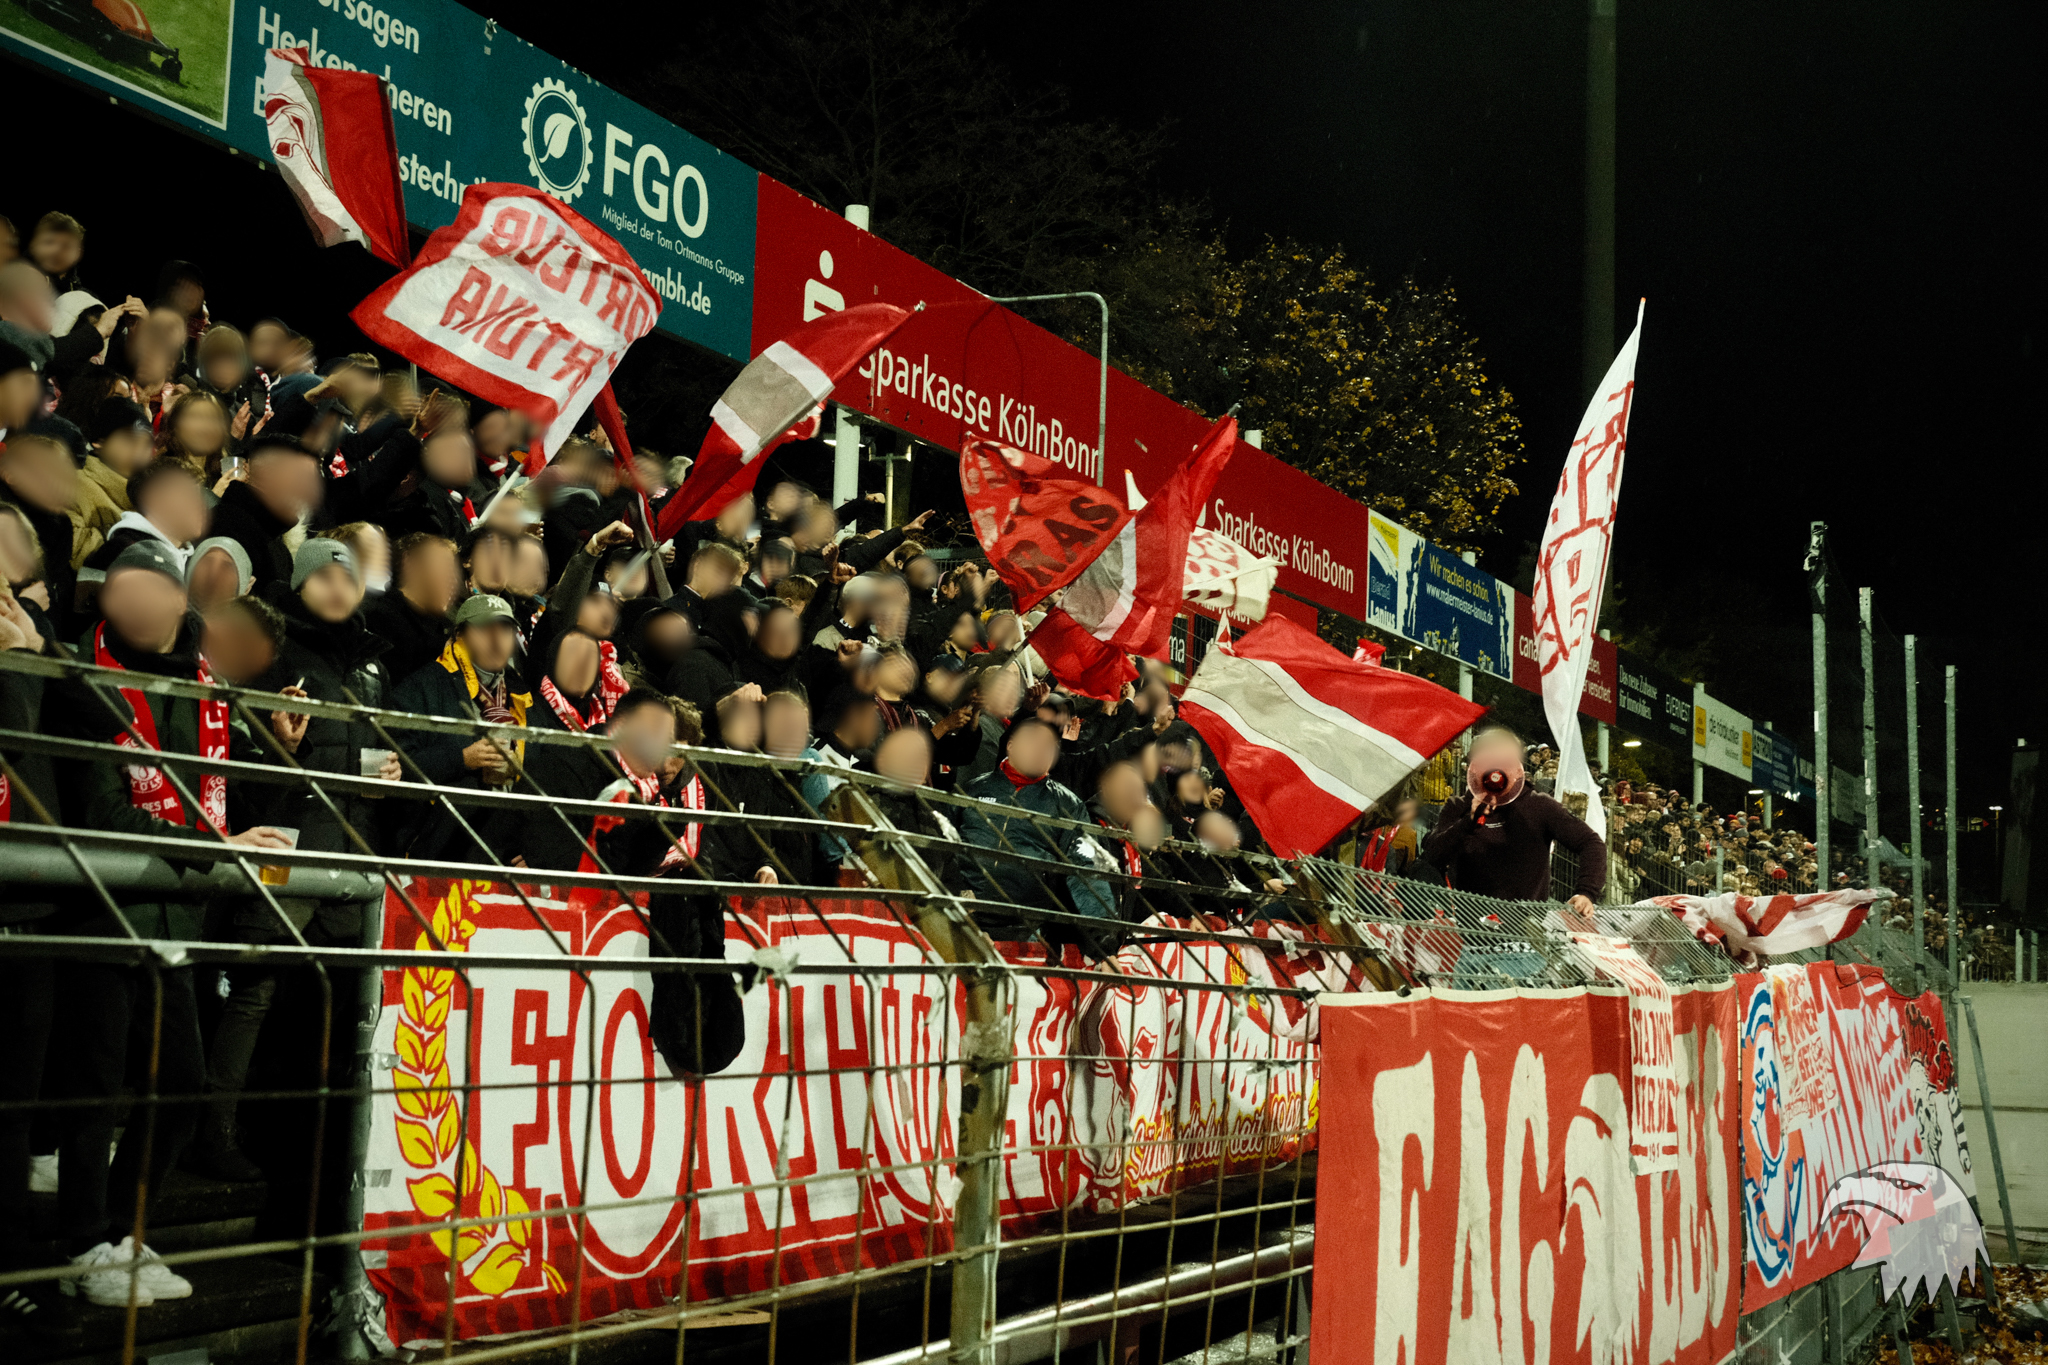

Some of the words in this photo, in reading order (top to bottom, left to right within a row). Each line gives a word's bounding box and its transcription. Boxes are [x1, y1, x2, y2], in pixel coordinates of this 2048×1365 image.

[257, 6, 453, 136] Hekeheren
[603, 122, 709, 238] FGO
[602, 204, 637, 234] Mitglied
[640, 223, 654, 241] der
[656, 230, 672, 250] Tom
[675, 239, 713, 270] Ortmanns
[715, 259, 745, 285] Gruppe
[1214, 498, 1289, 565] Sparkasse
[1292, 534, 1354, 594] KölnBonn
[1429, 553, 1442, 577] Wir
[1442, 566, 1464, 590] machen
[1465, 579, 1472, 594] es
[1370, 600, 1396, 629] Lanius
